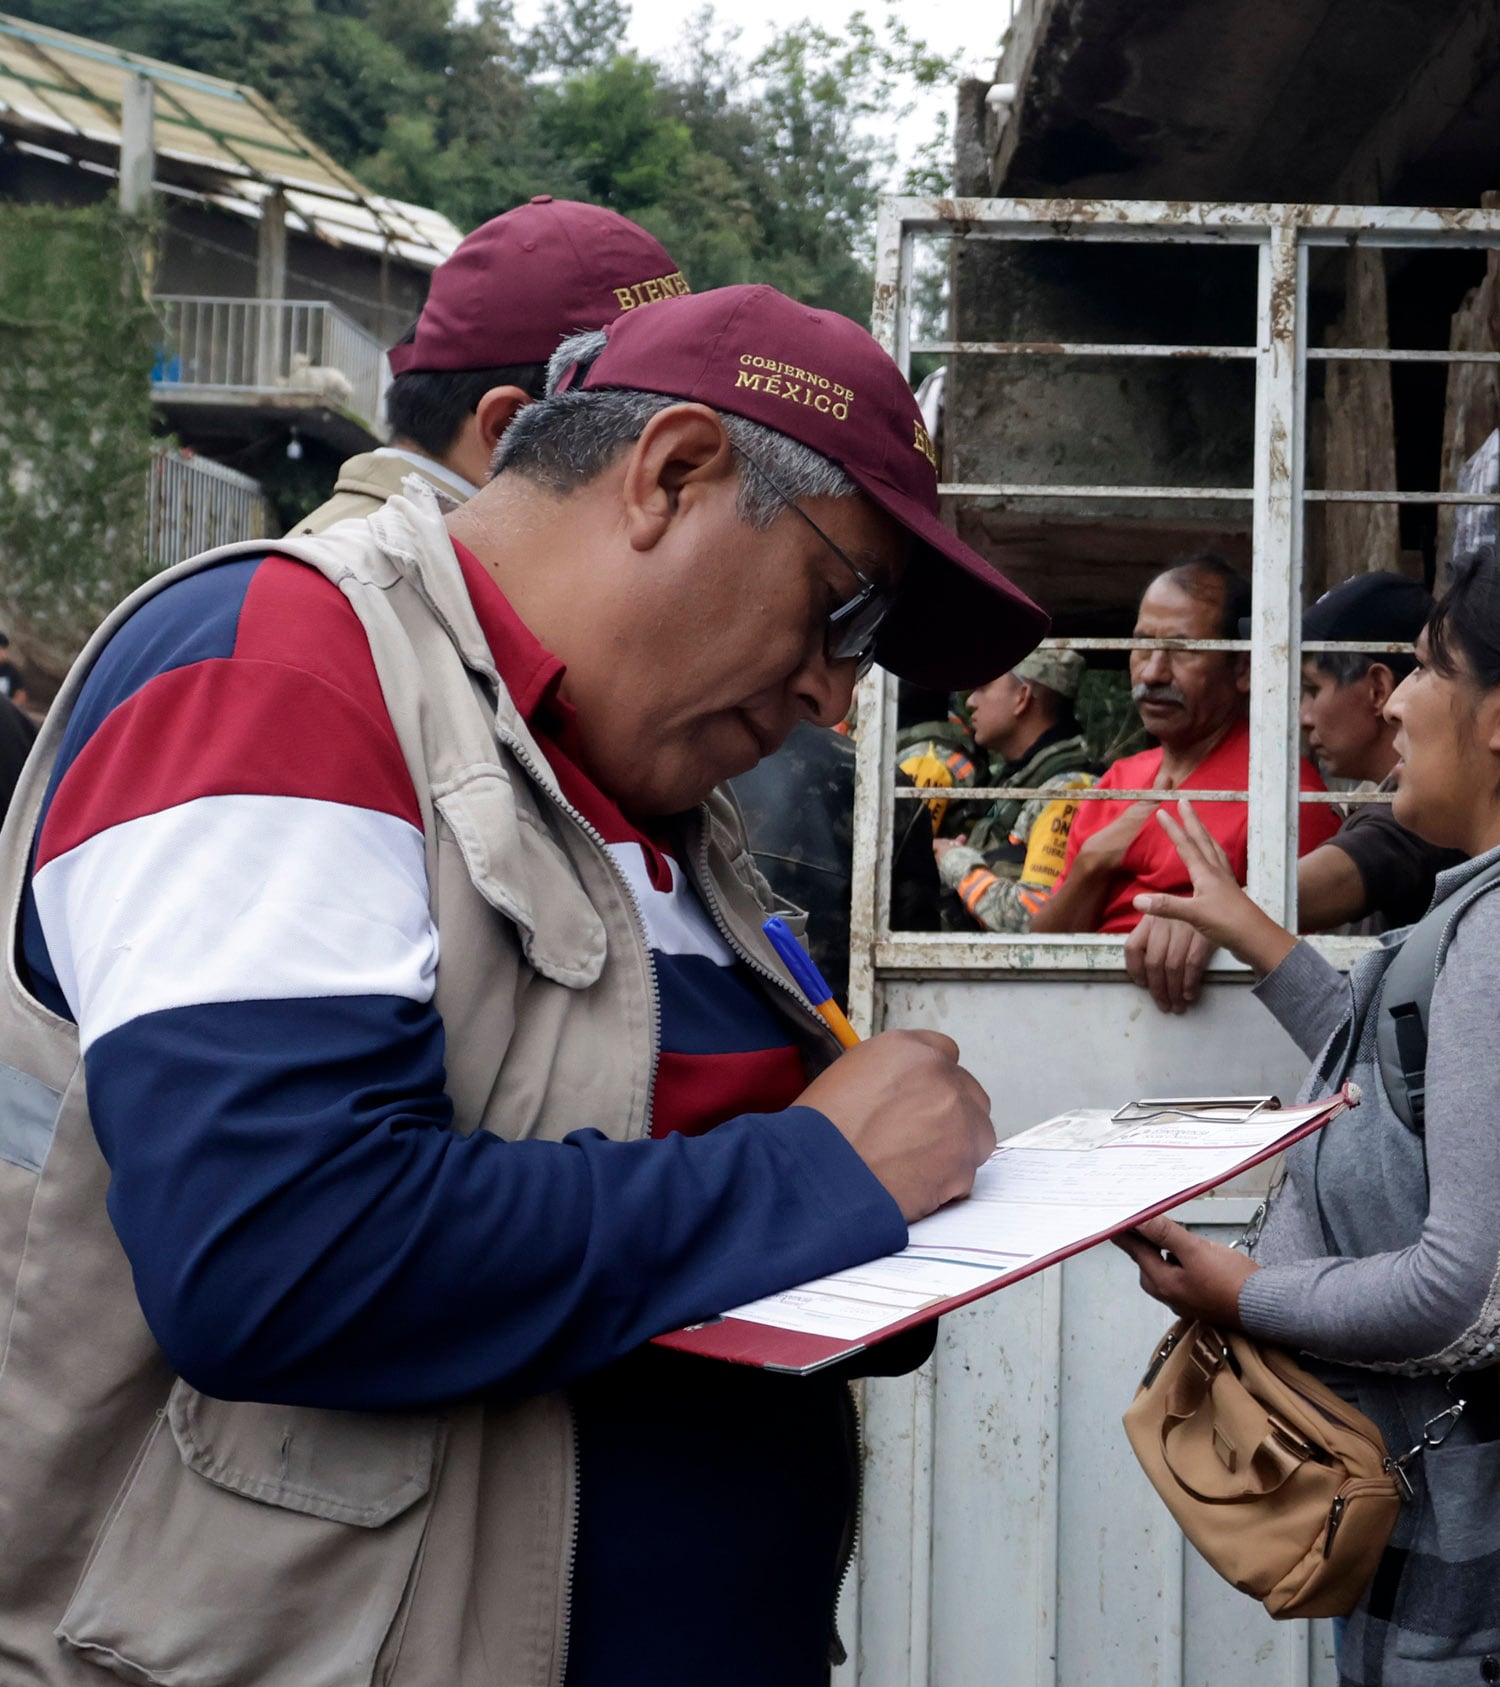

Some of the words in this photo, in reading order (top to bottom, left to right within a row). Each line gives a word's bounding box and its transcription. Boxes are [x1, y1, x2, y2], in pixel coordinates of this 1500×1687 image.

[735, 370, 850, 421] MÉXICO
[739, 354, 831, 390] GOBIERNO
[831, 381, 855, 402] DE
